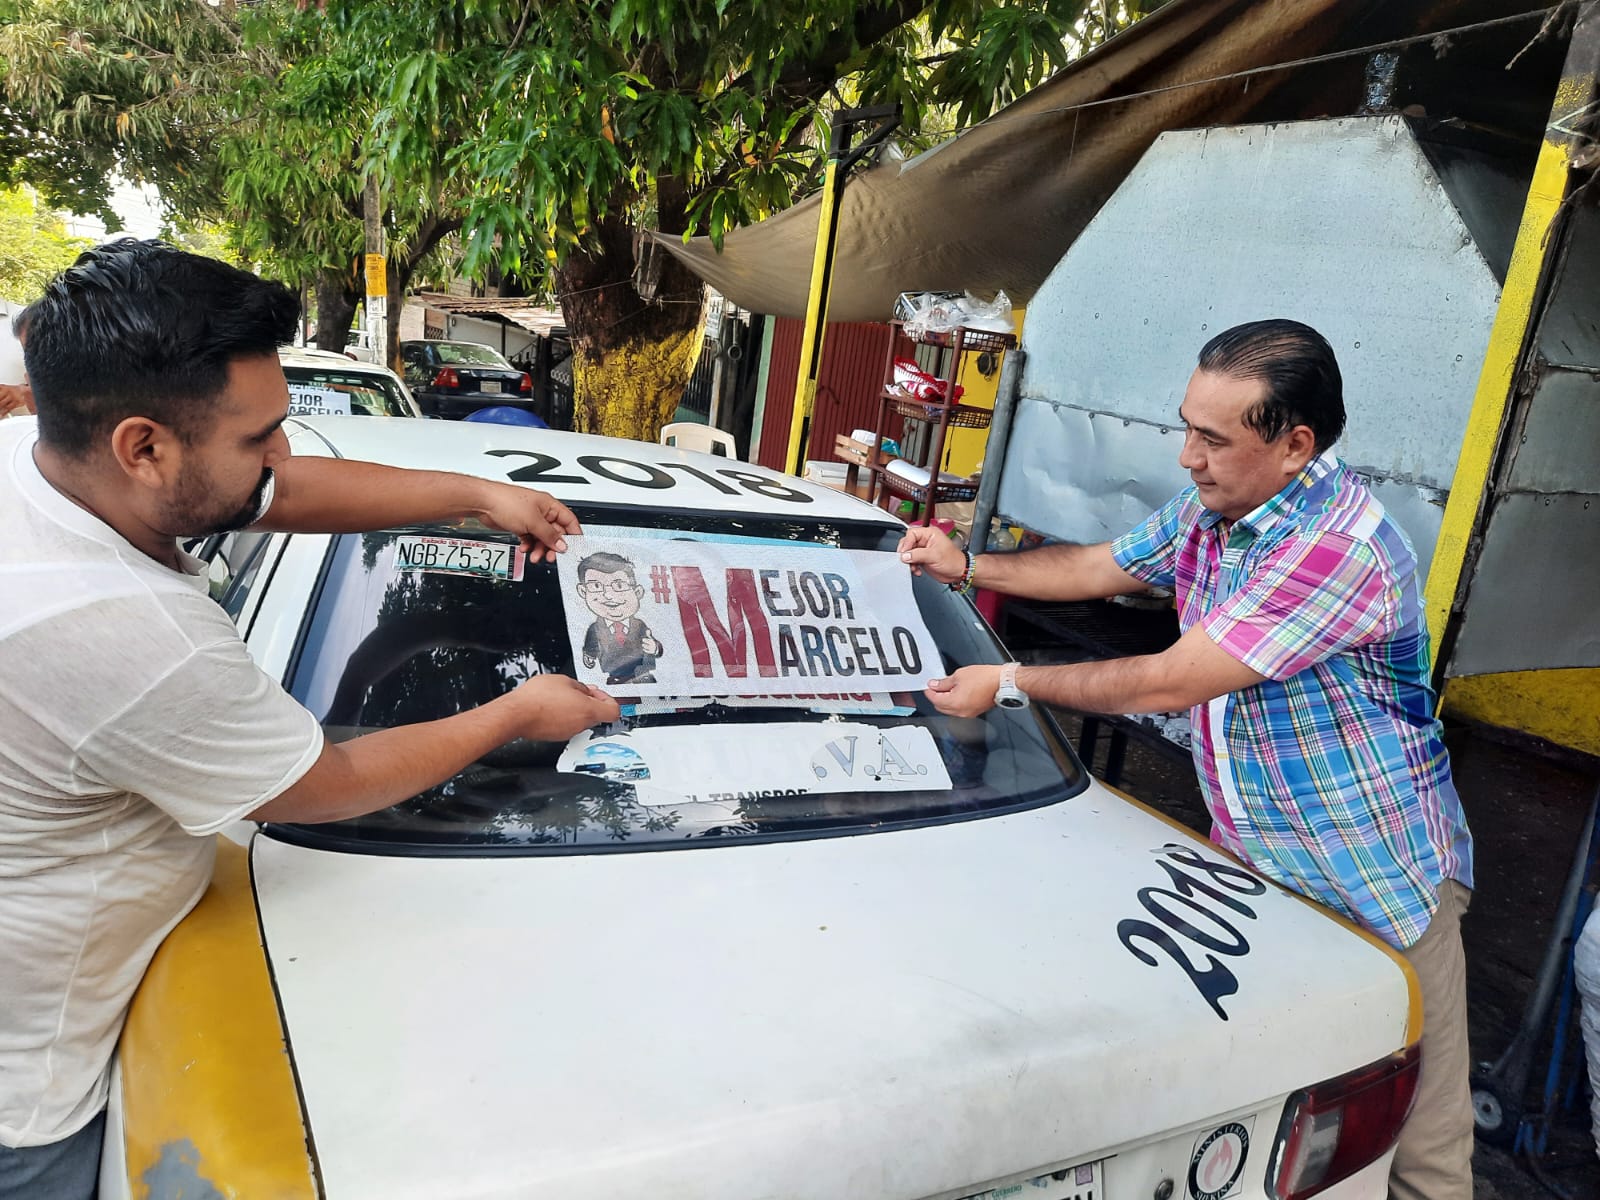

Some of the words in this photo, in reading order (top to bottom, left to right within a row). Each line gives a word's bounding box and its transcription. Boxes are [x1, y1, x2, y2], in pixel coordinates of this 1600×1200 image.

[288, 393, 323, 407] EJOR
[484, 449, 815, 503] 2018
[399, 542, 506, 572] NGB-75-37
[1117, 842, 1268, 1022] 2018
